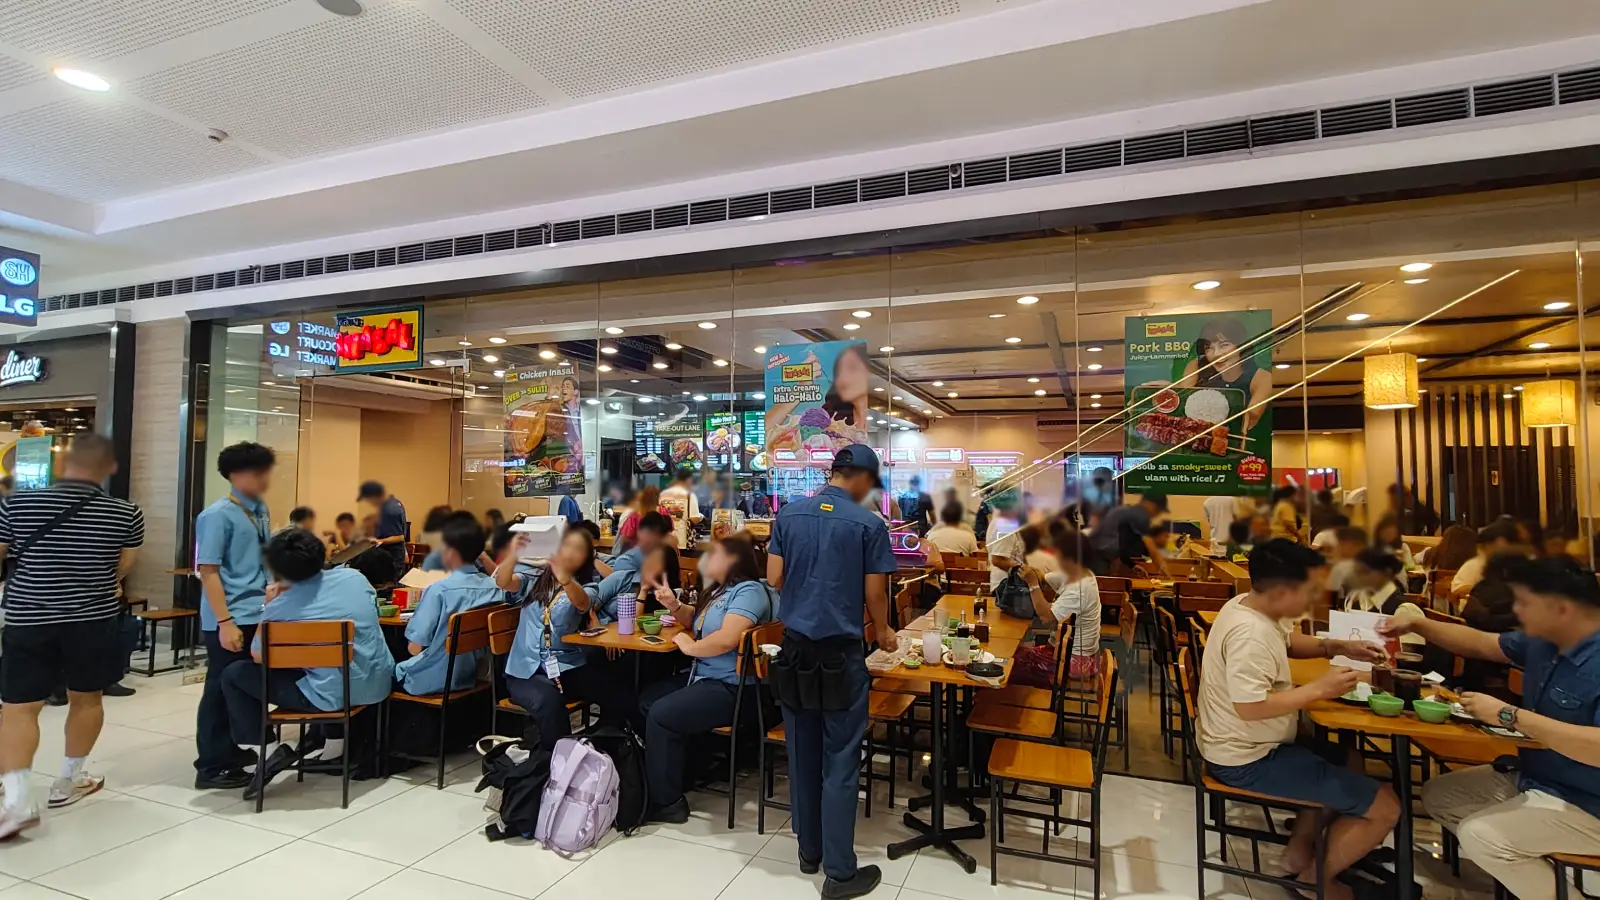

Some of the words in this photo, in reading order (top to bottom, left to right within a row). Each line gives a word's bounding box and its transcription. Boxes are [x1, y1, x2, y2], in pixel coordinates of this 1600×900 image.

[0, 294, 34, 316] LG
[1130, 342, 1160, 353] Pork
[1165, 341, 1190, 352] BBQ
[1, 350, 41, 380] diner
[520, 369, 548, 380] Chicken
[549, 366, 574, 376] Inasal
[793, 385, 820, 393] Creamy
[505, 391, 520, 405] OVER
[773, 392, 822, 403] Halo-Halo
[1171, 463, 1232, 472] smoky-sweet
[1145, 474, 1168, 482] ulam
[1170, 474, 1189, 482] with
[1192, 474, 1212, 482] rice!
